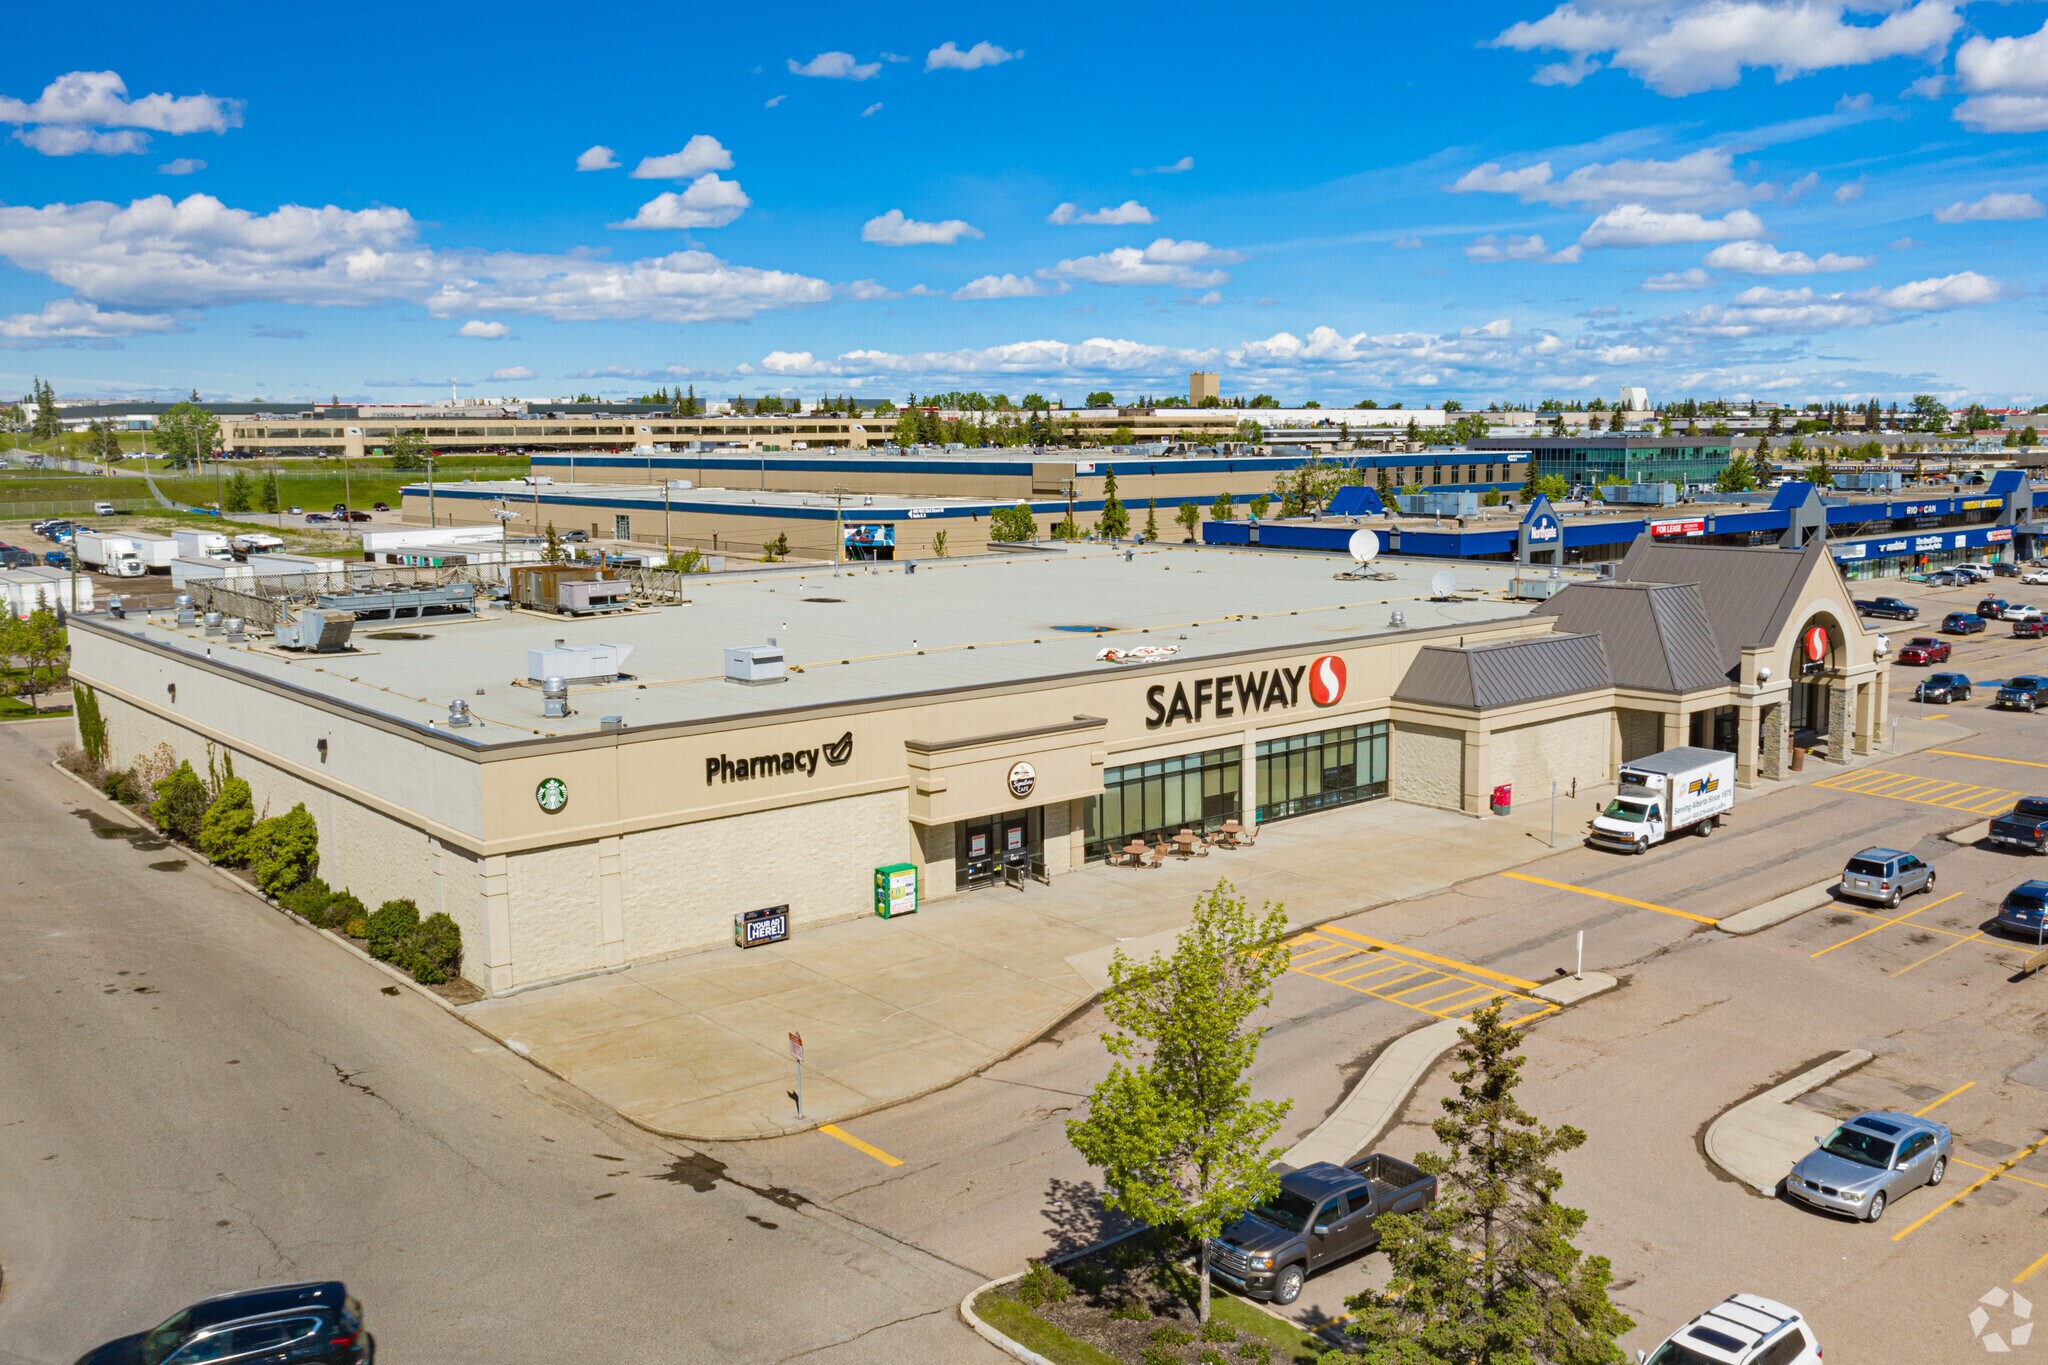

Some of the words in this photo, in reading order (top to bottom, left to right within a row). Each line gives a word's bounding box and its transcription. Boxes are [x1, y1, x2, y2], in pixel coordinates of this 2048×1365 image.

[1906, 506, 1917, 515] RIO
[1923, 505, 1936, 513] CAN
[1531, 526, 1557, 540] Northgate
[1656, 525, 1666, 534] FOR
[1667, 524, 1682, 533] LEASE
[1146, 665, 1307, 730] SAFEWAY
[706, 748, 820, 786] Pharmacy
[1674, 804, 1691, 815] Serving
[1692, 799, 1708, 808] Alberta
[1708, 794, 1721, 803] Since
[752, 920, 770, 930] YOUR
[771, 918, 780, 927] AD
[752, 924, 781, 940] HERE!
